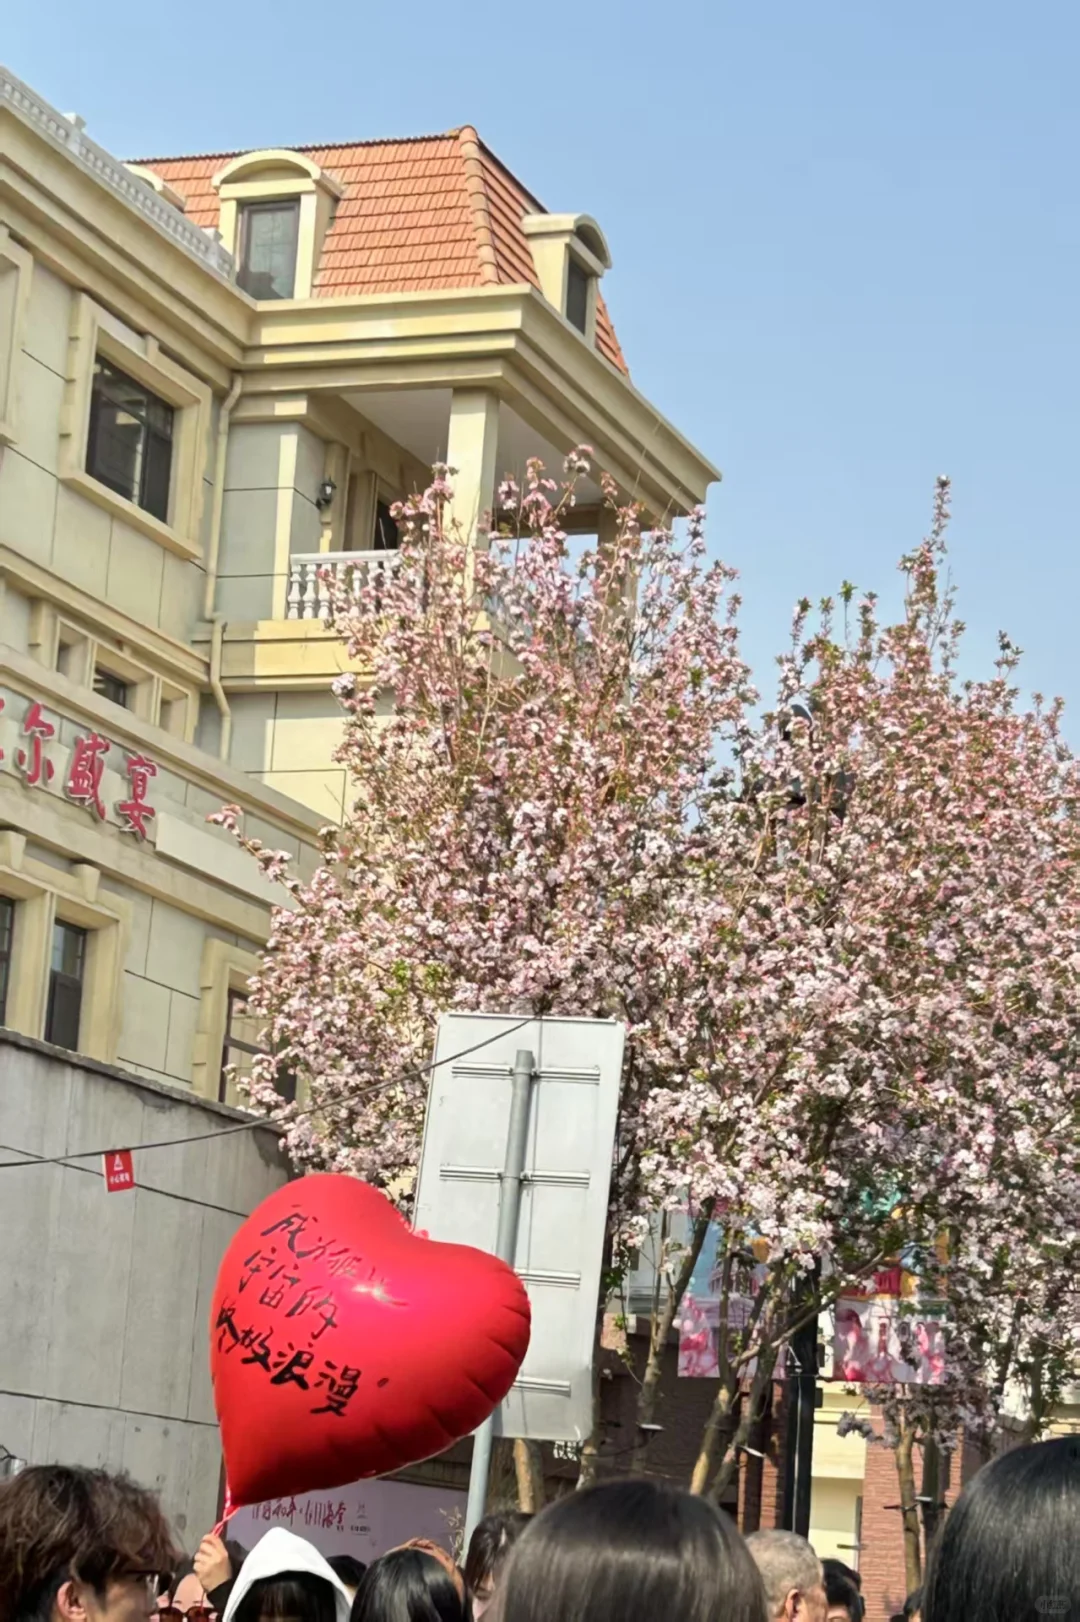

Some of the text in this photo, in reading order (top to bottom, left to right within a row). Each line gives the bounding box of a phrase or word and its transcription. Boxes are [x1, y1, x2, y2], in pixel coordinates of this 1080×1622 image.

[0, 697, 157, 841] 尔盛宴
[239, 1246, 339, 1341] 宇宙的
